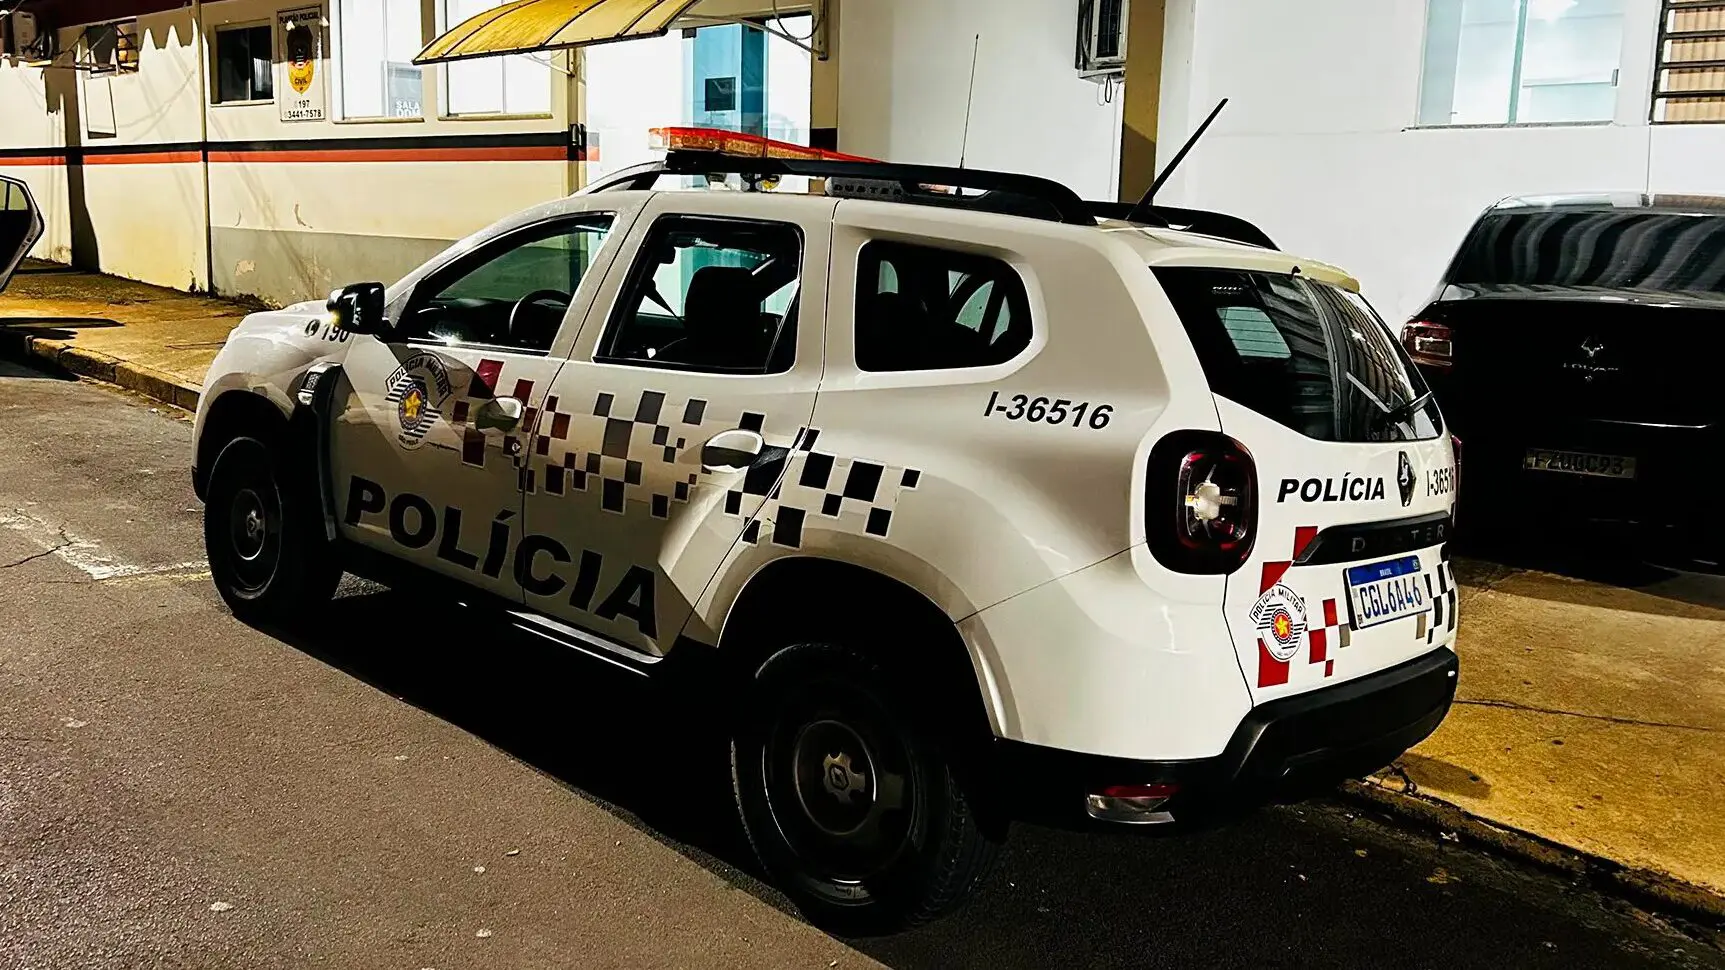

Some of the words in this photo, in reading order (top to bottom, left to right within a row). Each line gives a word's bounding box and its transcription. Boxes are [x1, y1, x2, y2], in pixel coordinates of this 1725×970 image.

[288, 110, 321, 119] 3441-7578
[298, 100, 310, 108] 197
[396, 101, 420, 110] SALA
[833, 184, 902, 196] DUSTER
[984, 391, 1114, 430] I-36516
[1277, 472, 1385, 503] POLÍCIA
[344, 475, 658, 641] POLÍCIA
[1278, 588, 1303, 613] MILITAR
[1360, 577, 1422, 619] CGL6A46
